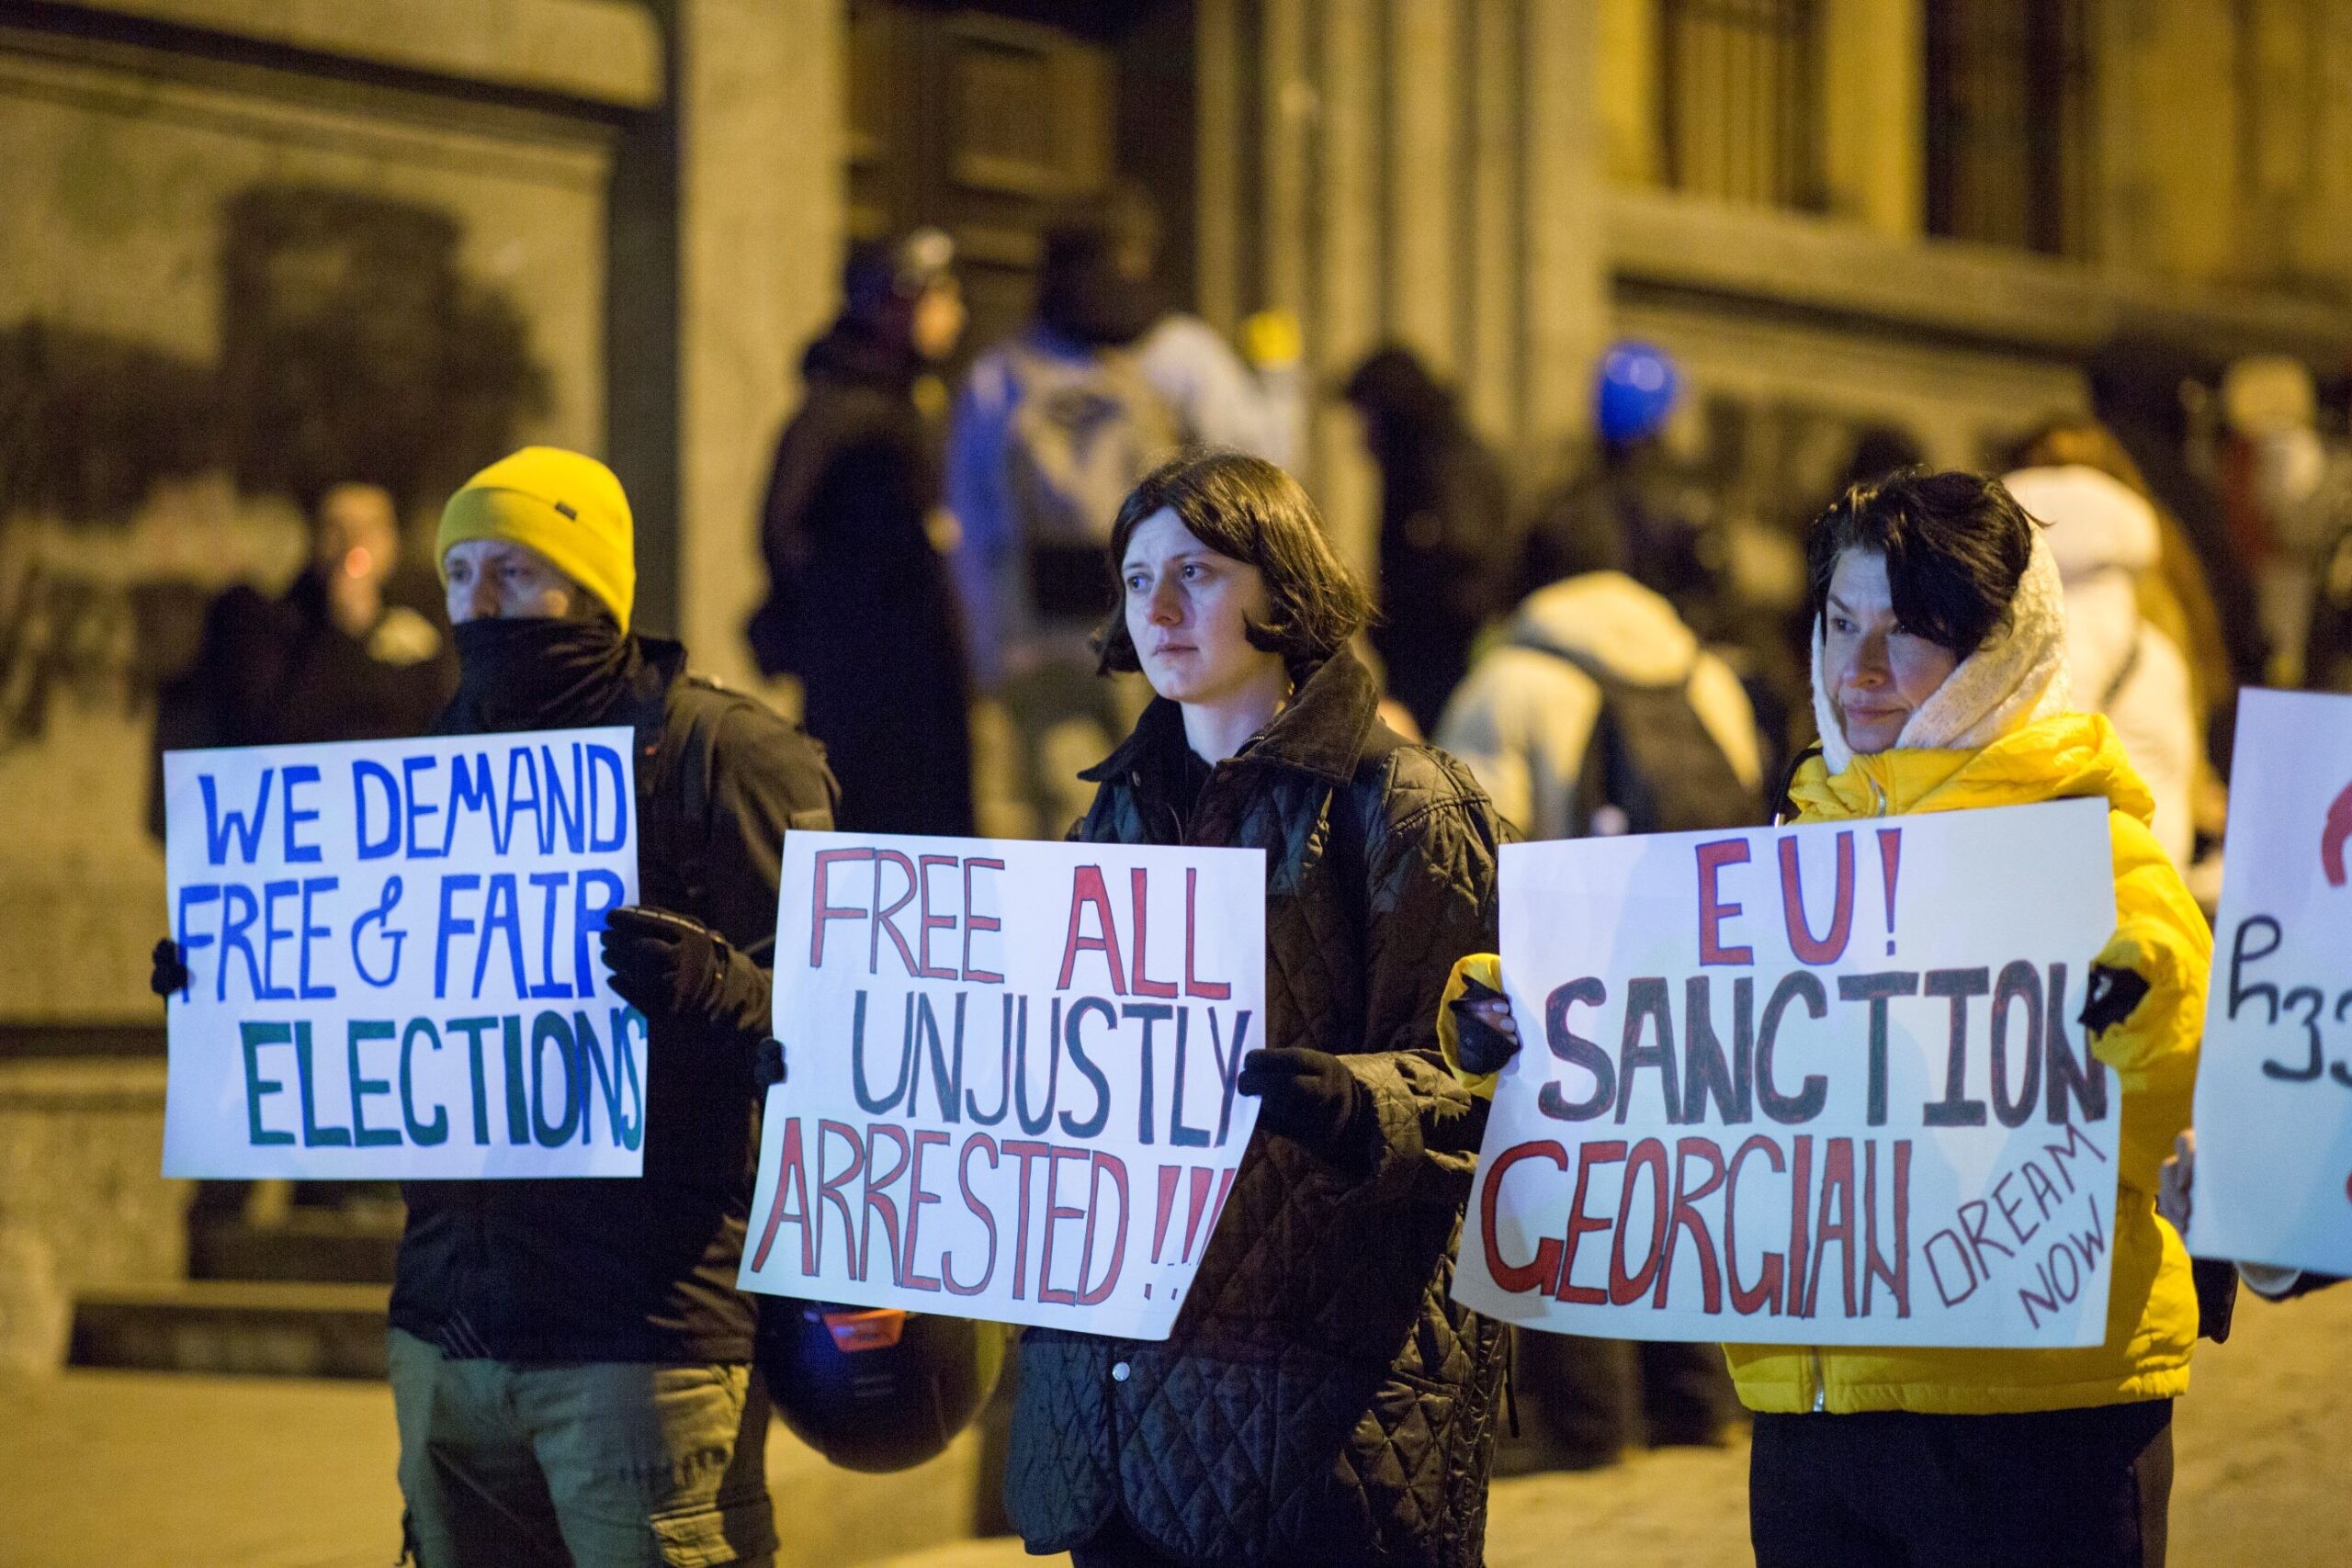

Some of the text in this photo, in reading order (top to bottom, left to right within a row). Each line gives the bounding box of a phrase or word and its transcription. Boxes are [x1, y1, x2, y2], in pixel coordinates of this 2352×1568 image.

[198, 742, 628, 864] WE DEMAND
[177, 868, 625, 1003] FREE & FAIR
[809, 847, 1231, 999] FREE ALL
[1695, 828, 1902, 965] EU!
[240, 1005, 648, 1151] ELECTIONS
[852, 989, 1253, 1148] UNJUSTLY
[1538, 960, 2108, 1127] SANCTION
[1481, 1134, 1912, 1319] GEORGIAN
[1923, 1122, 2107, 1308] DREAM
[2018, 1193, 2106, 1329] NOW
